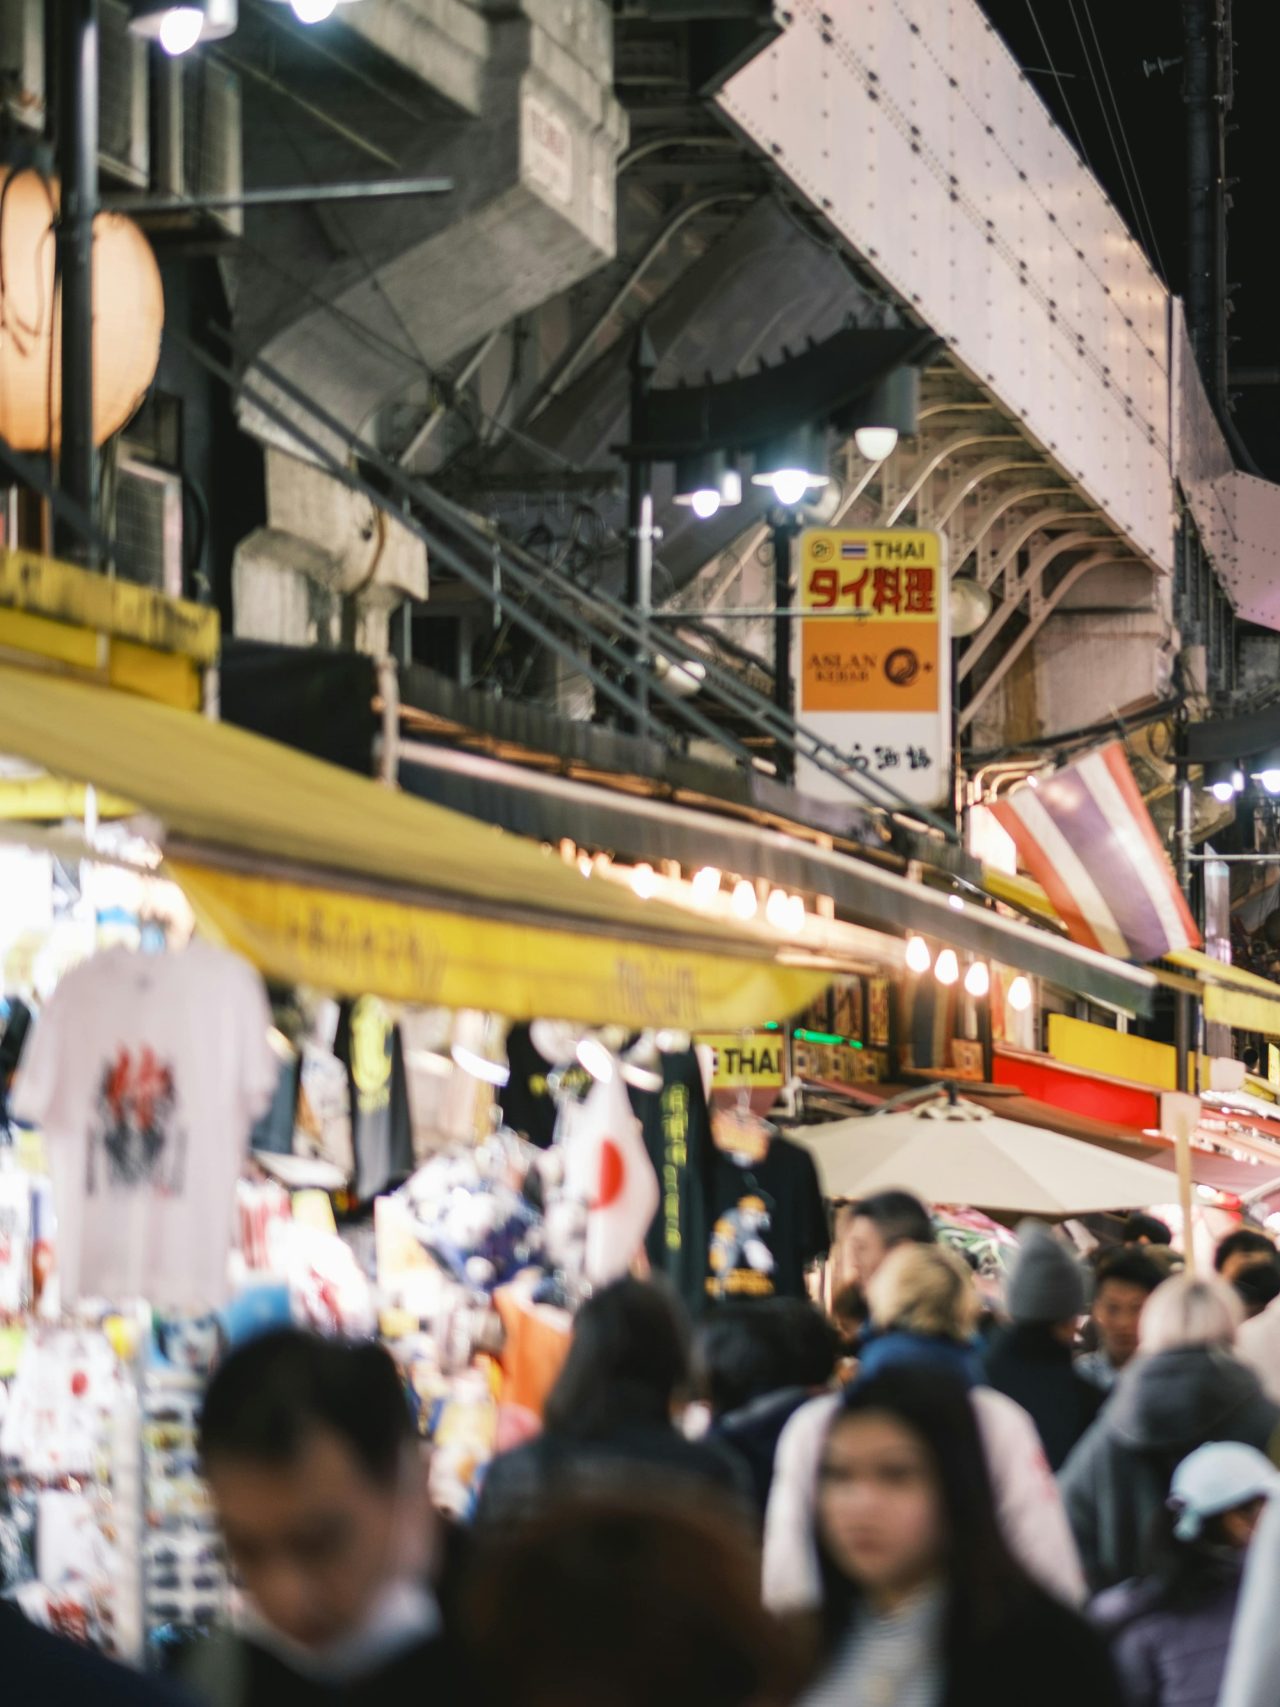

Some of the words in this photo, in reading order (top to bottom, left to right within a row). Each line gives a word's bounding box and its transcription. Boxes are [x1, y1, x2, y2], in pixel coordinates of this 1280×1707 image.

[873, 542, 925, 560] THAI
[809, 566, 936, 615] タイ料理
[723, 1047, 781, 1075] THAI
